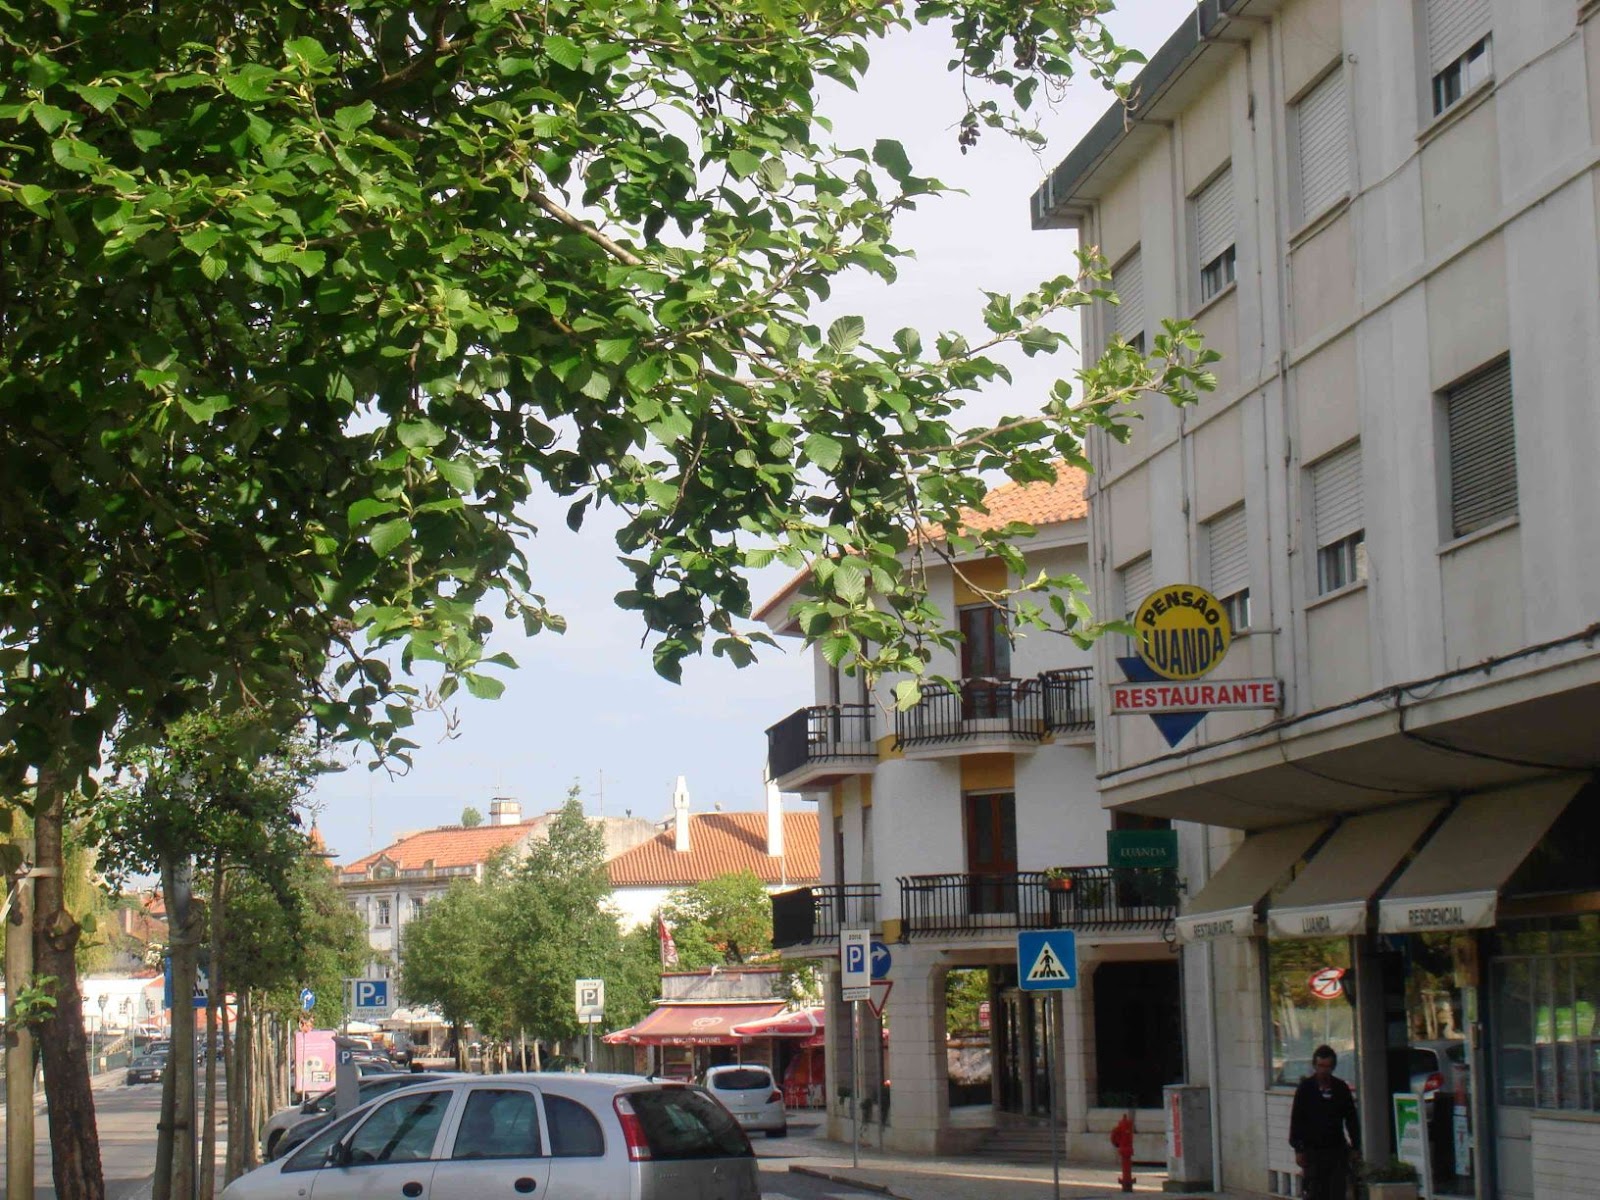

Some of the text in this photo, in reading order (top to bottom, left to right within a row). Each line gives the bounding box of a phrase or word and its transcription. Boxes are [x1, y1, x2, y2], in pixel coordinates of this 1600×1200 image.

[1142, 591, 1220, 626] PENSÃO
[1142, 627, 1224, 675] LUANDA
[1115, 683, 1276, 708] RESTAURANTE
[1120, 847, 1167, 857] LUANDA
[1302, 916, 1331, 934] LUANDA
[1408, 906, 1465, 926] RESIDENCIAL
[1193, 920, 1235, 939] RESTAURANTE
[849, 946, 861, 972] P
[360, 982, 375, 1005] P
[583, 990, 596, 1005] P
[341, 1051, 350, 1065] P
